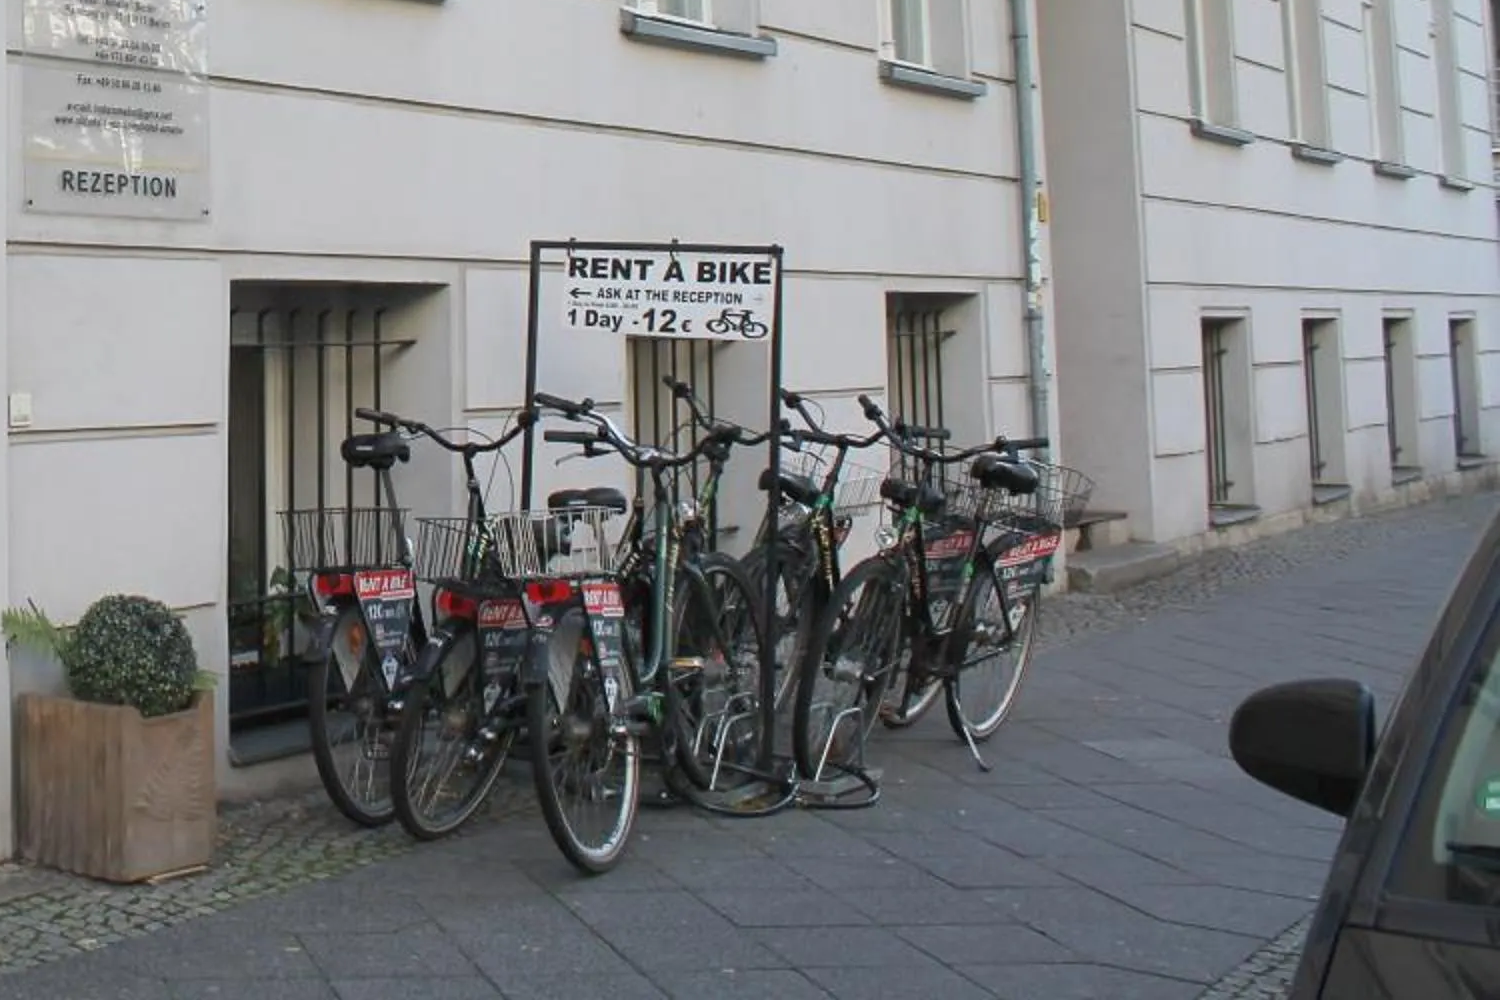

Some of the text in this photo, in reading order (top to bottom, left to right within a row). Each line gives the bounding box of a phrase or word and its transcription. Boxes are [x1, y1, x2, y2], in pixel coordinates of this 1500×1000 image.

[61, 169, 177, 197] REZEPTION
[569, 257, 772, 285] RENT A BIKE
[597, 287, 743, 305] ASK AT THE RECEPTION
[567, 308, 577, 327] 1
[585, 309, 623, 333] Day
[643, 307, 677, 333] 12
